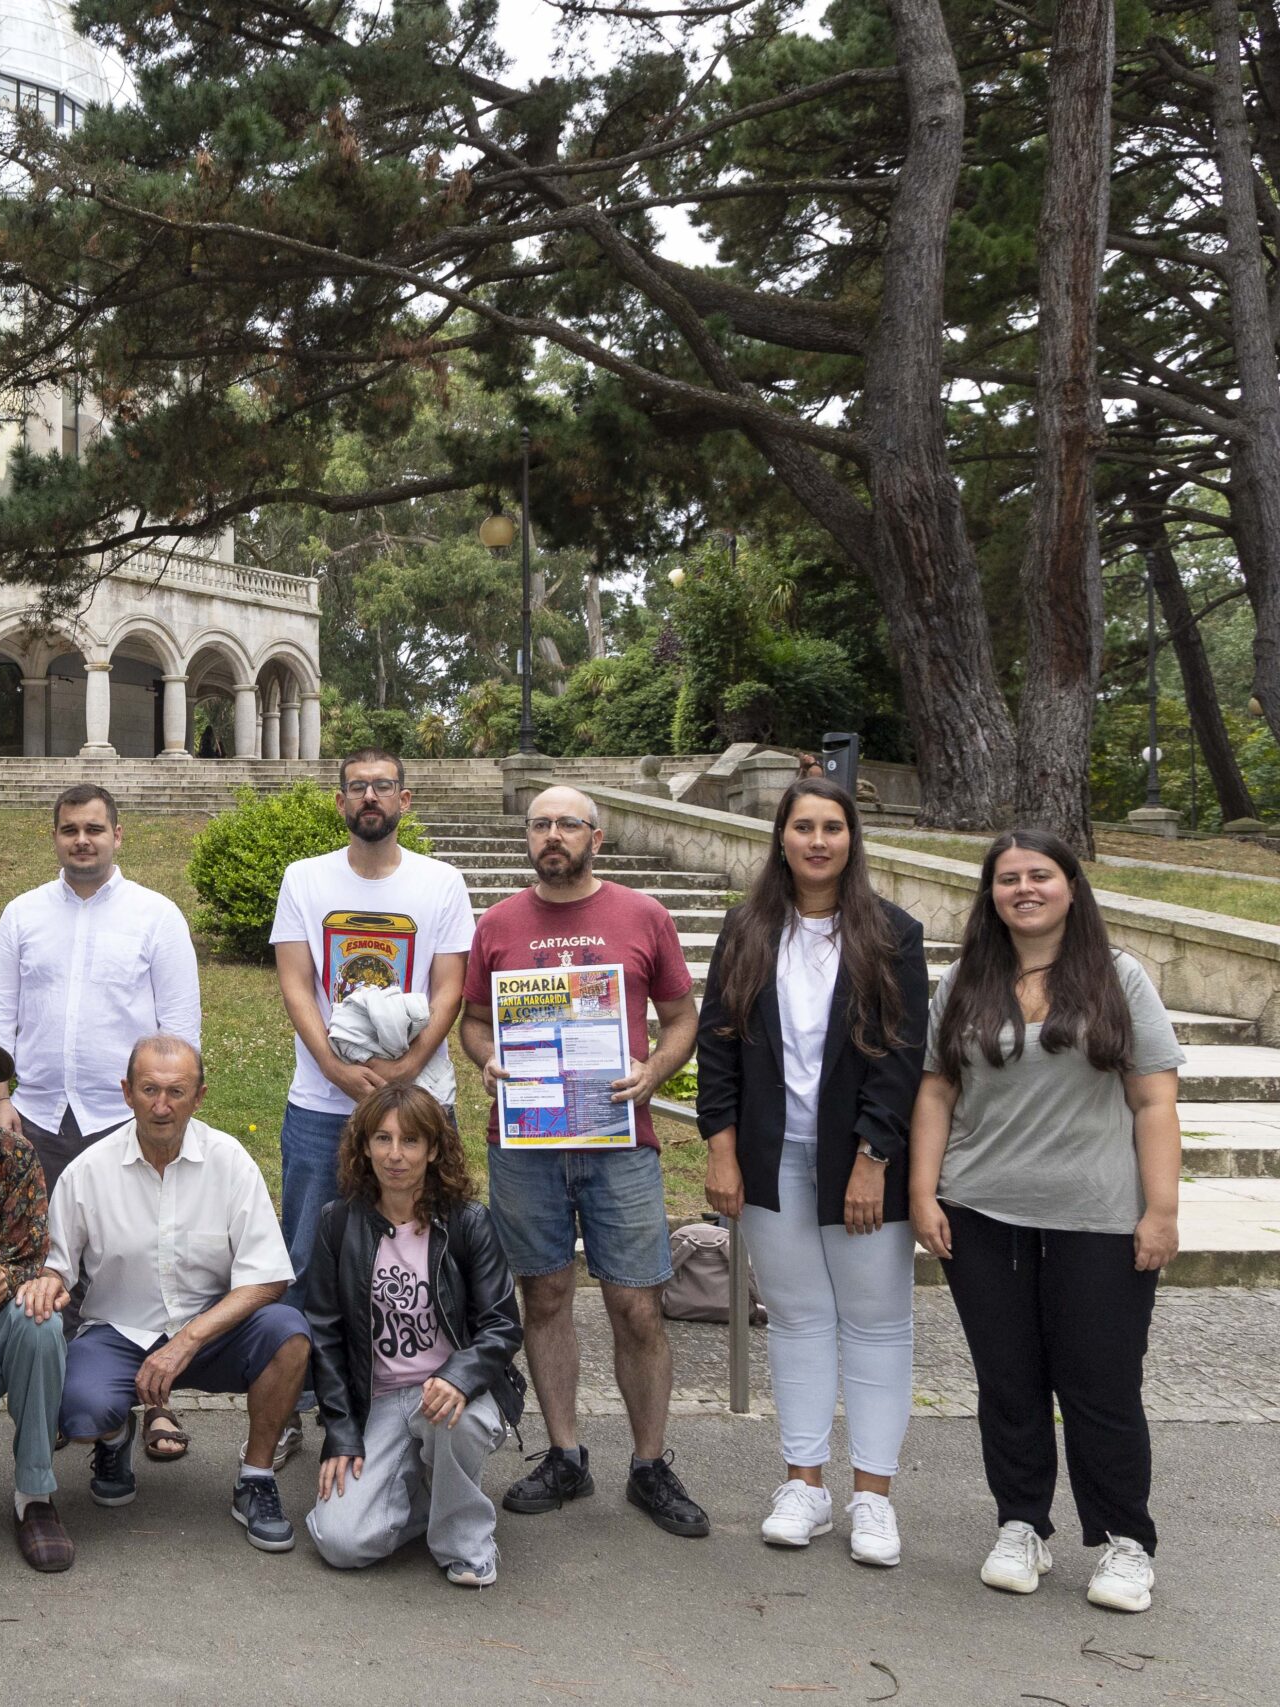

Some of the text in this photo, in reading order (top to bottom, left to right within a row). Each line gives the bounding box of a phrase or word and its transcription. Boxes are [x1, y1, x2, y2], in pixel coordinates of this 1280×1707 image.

[346, 940, 393, 955] ESMORGA
[529, 936, 606, 950] CARTAGENA
[499, 976, 567, 994] ROMARÍA
[499, 994, 567, 1007] SANTA MARGARIDA
[503, 1008, 512, 1019] A
